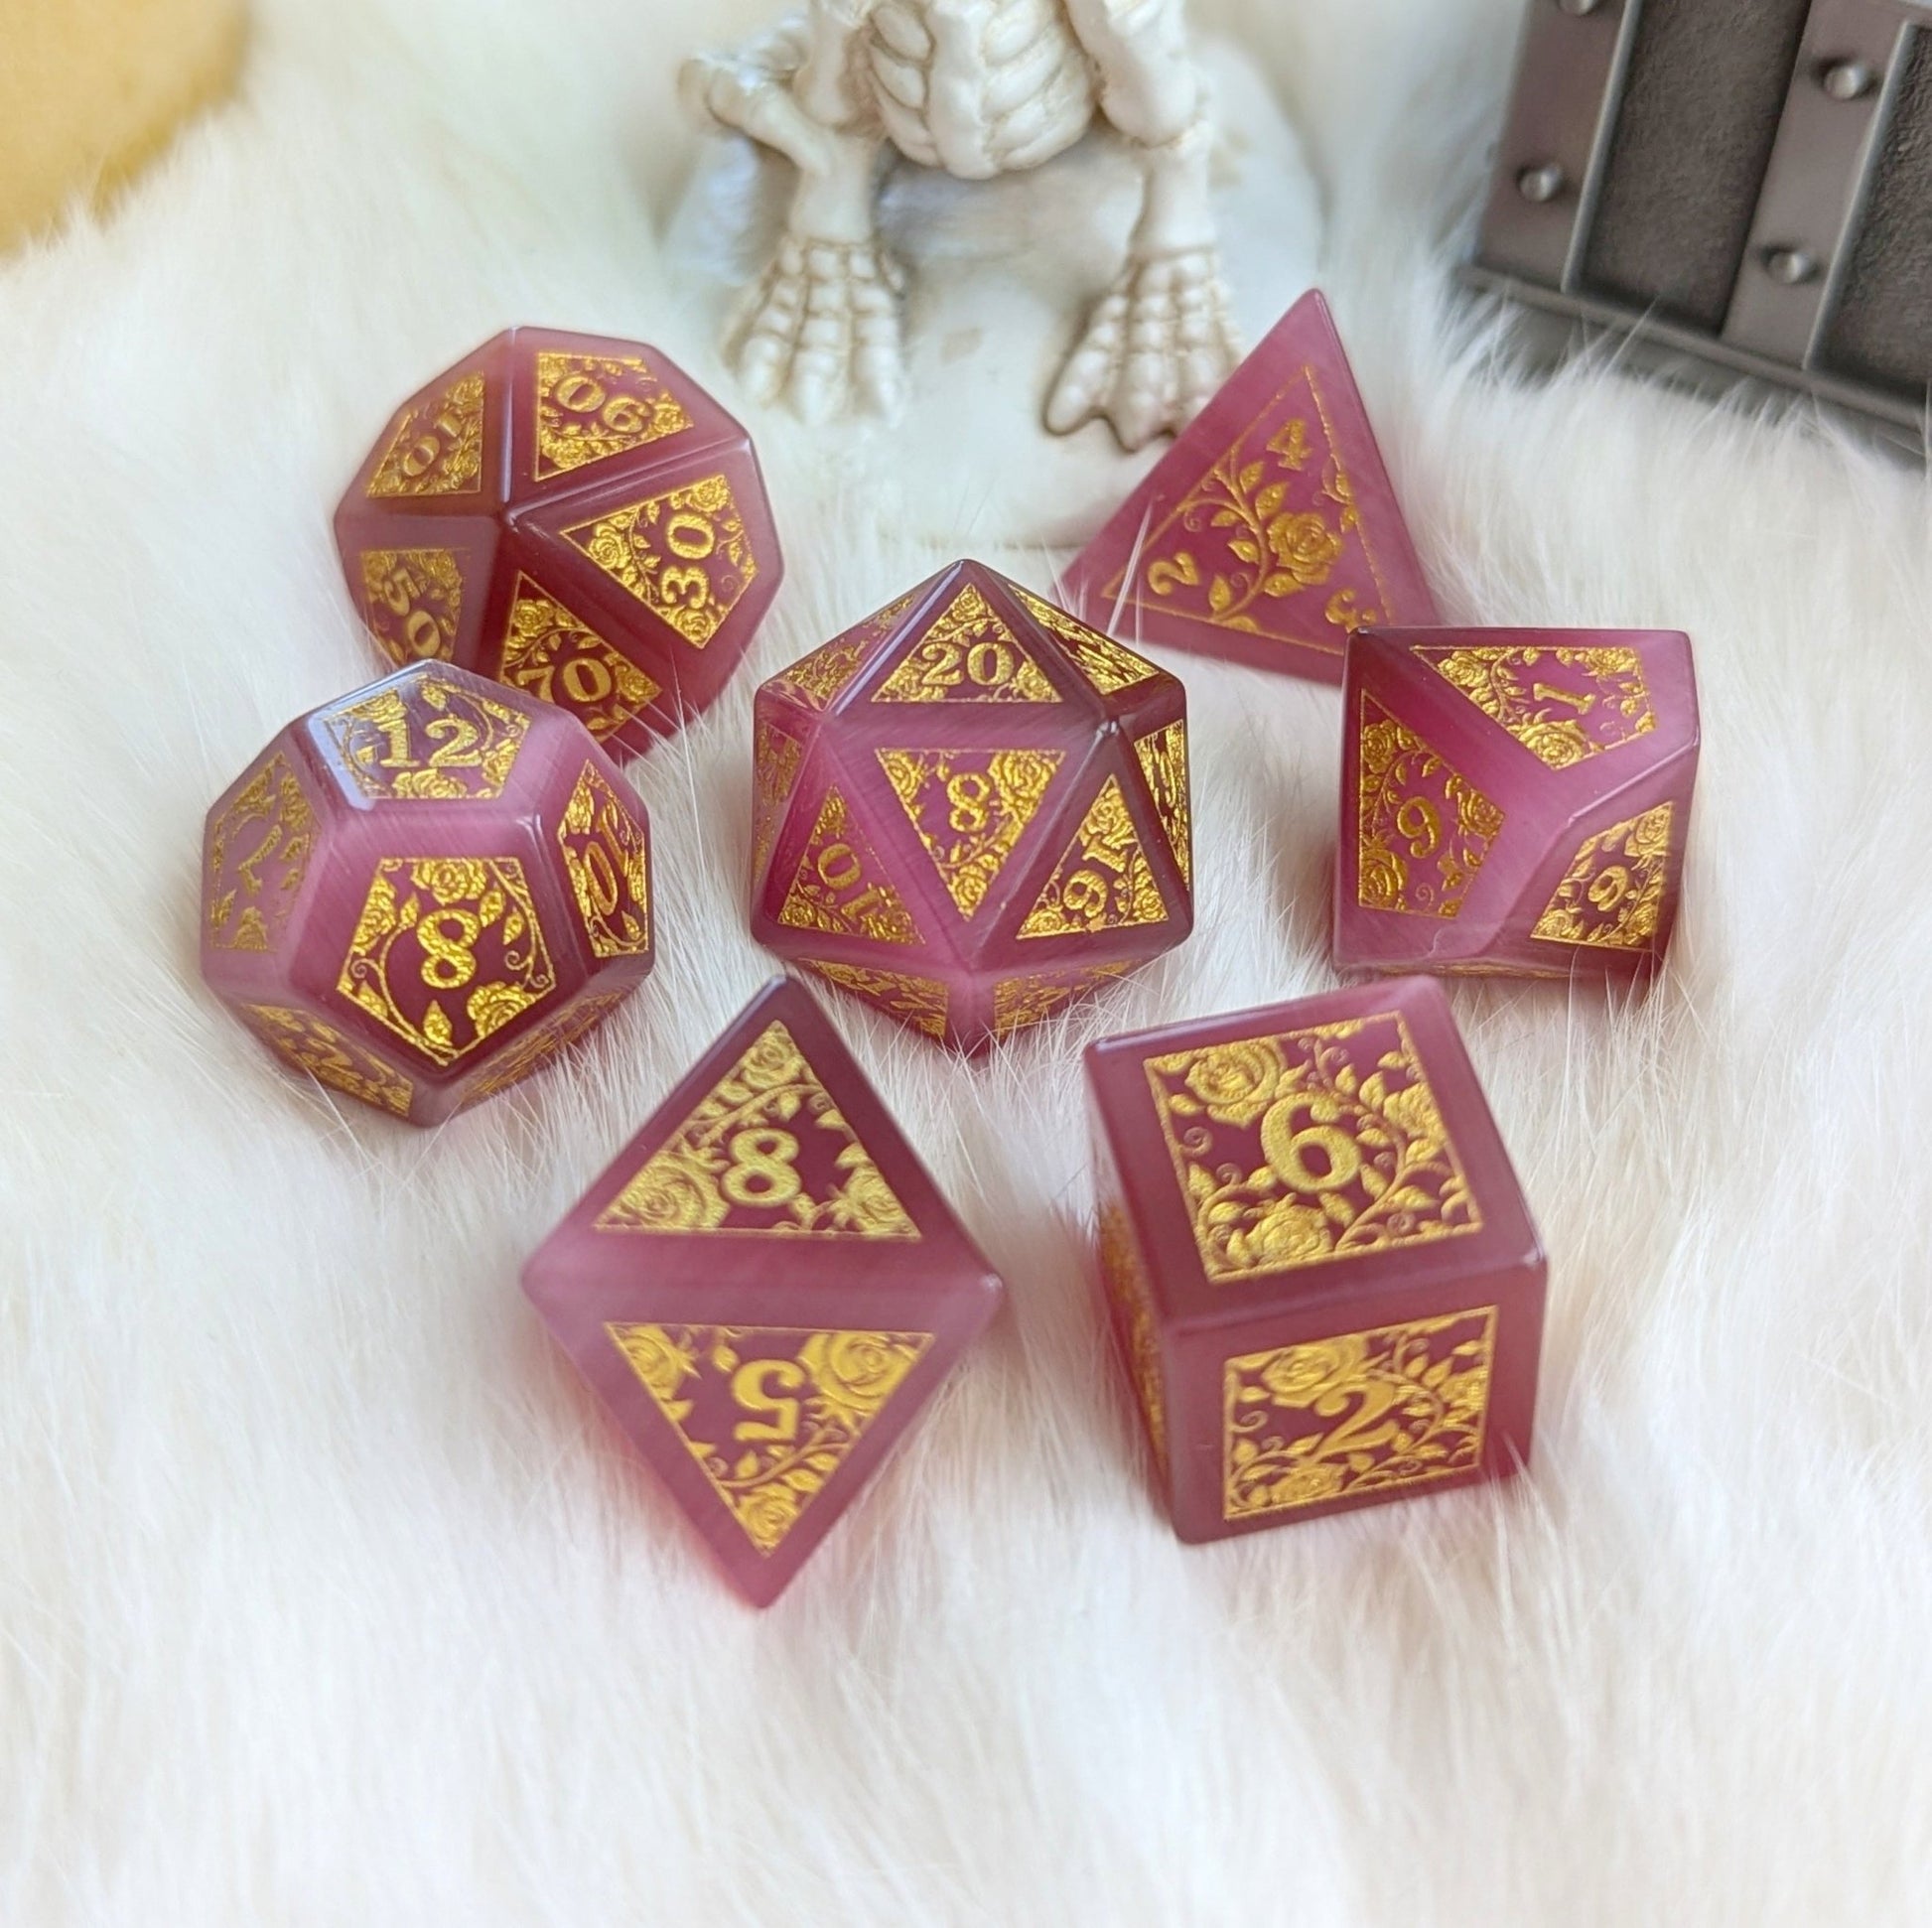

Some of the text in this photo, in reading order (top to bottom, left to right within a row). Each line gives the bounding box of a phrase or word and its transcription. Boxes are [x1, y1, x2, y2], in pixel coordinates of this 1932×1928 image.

[1266, 417, 1312, 471] 4
[659, 513, 716, 610] 30
[1148, 551, 1200, 596] 2
[517, 657, 612, 703] 70
[921, 642, 1015, 686] 20
[1533, 683, 1596, 715] 1
[378, 714, 483, 767] 12
[947, 772, 991, 834] 8
[582, 806, 629, 916] 10
[417, 908, 481, 989] 8
[722, 1128, 802, 1208] 8
[1261, 1091, 1362, 1192] 6
[732, 1360, 804, 1443] 5
[1309, 1379, 1401, 1460] 2
